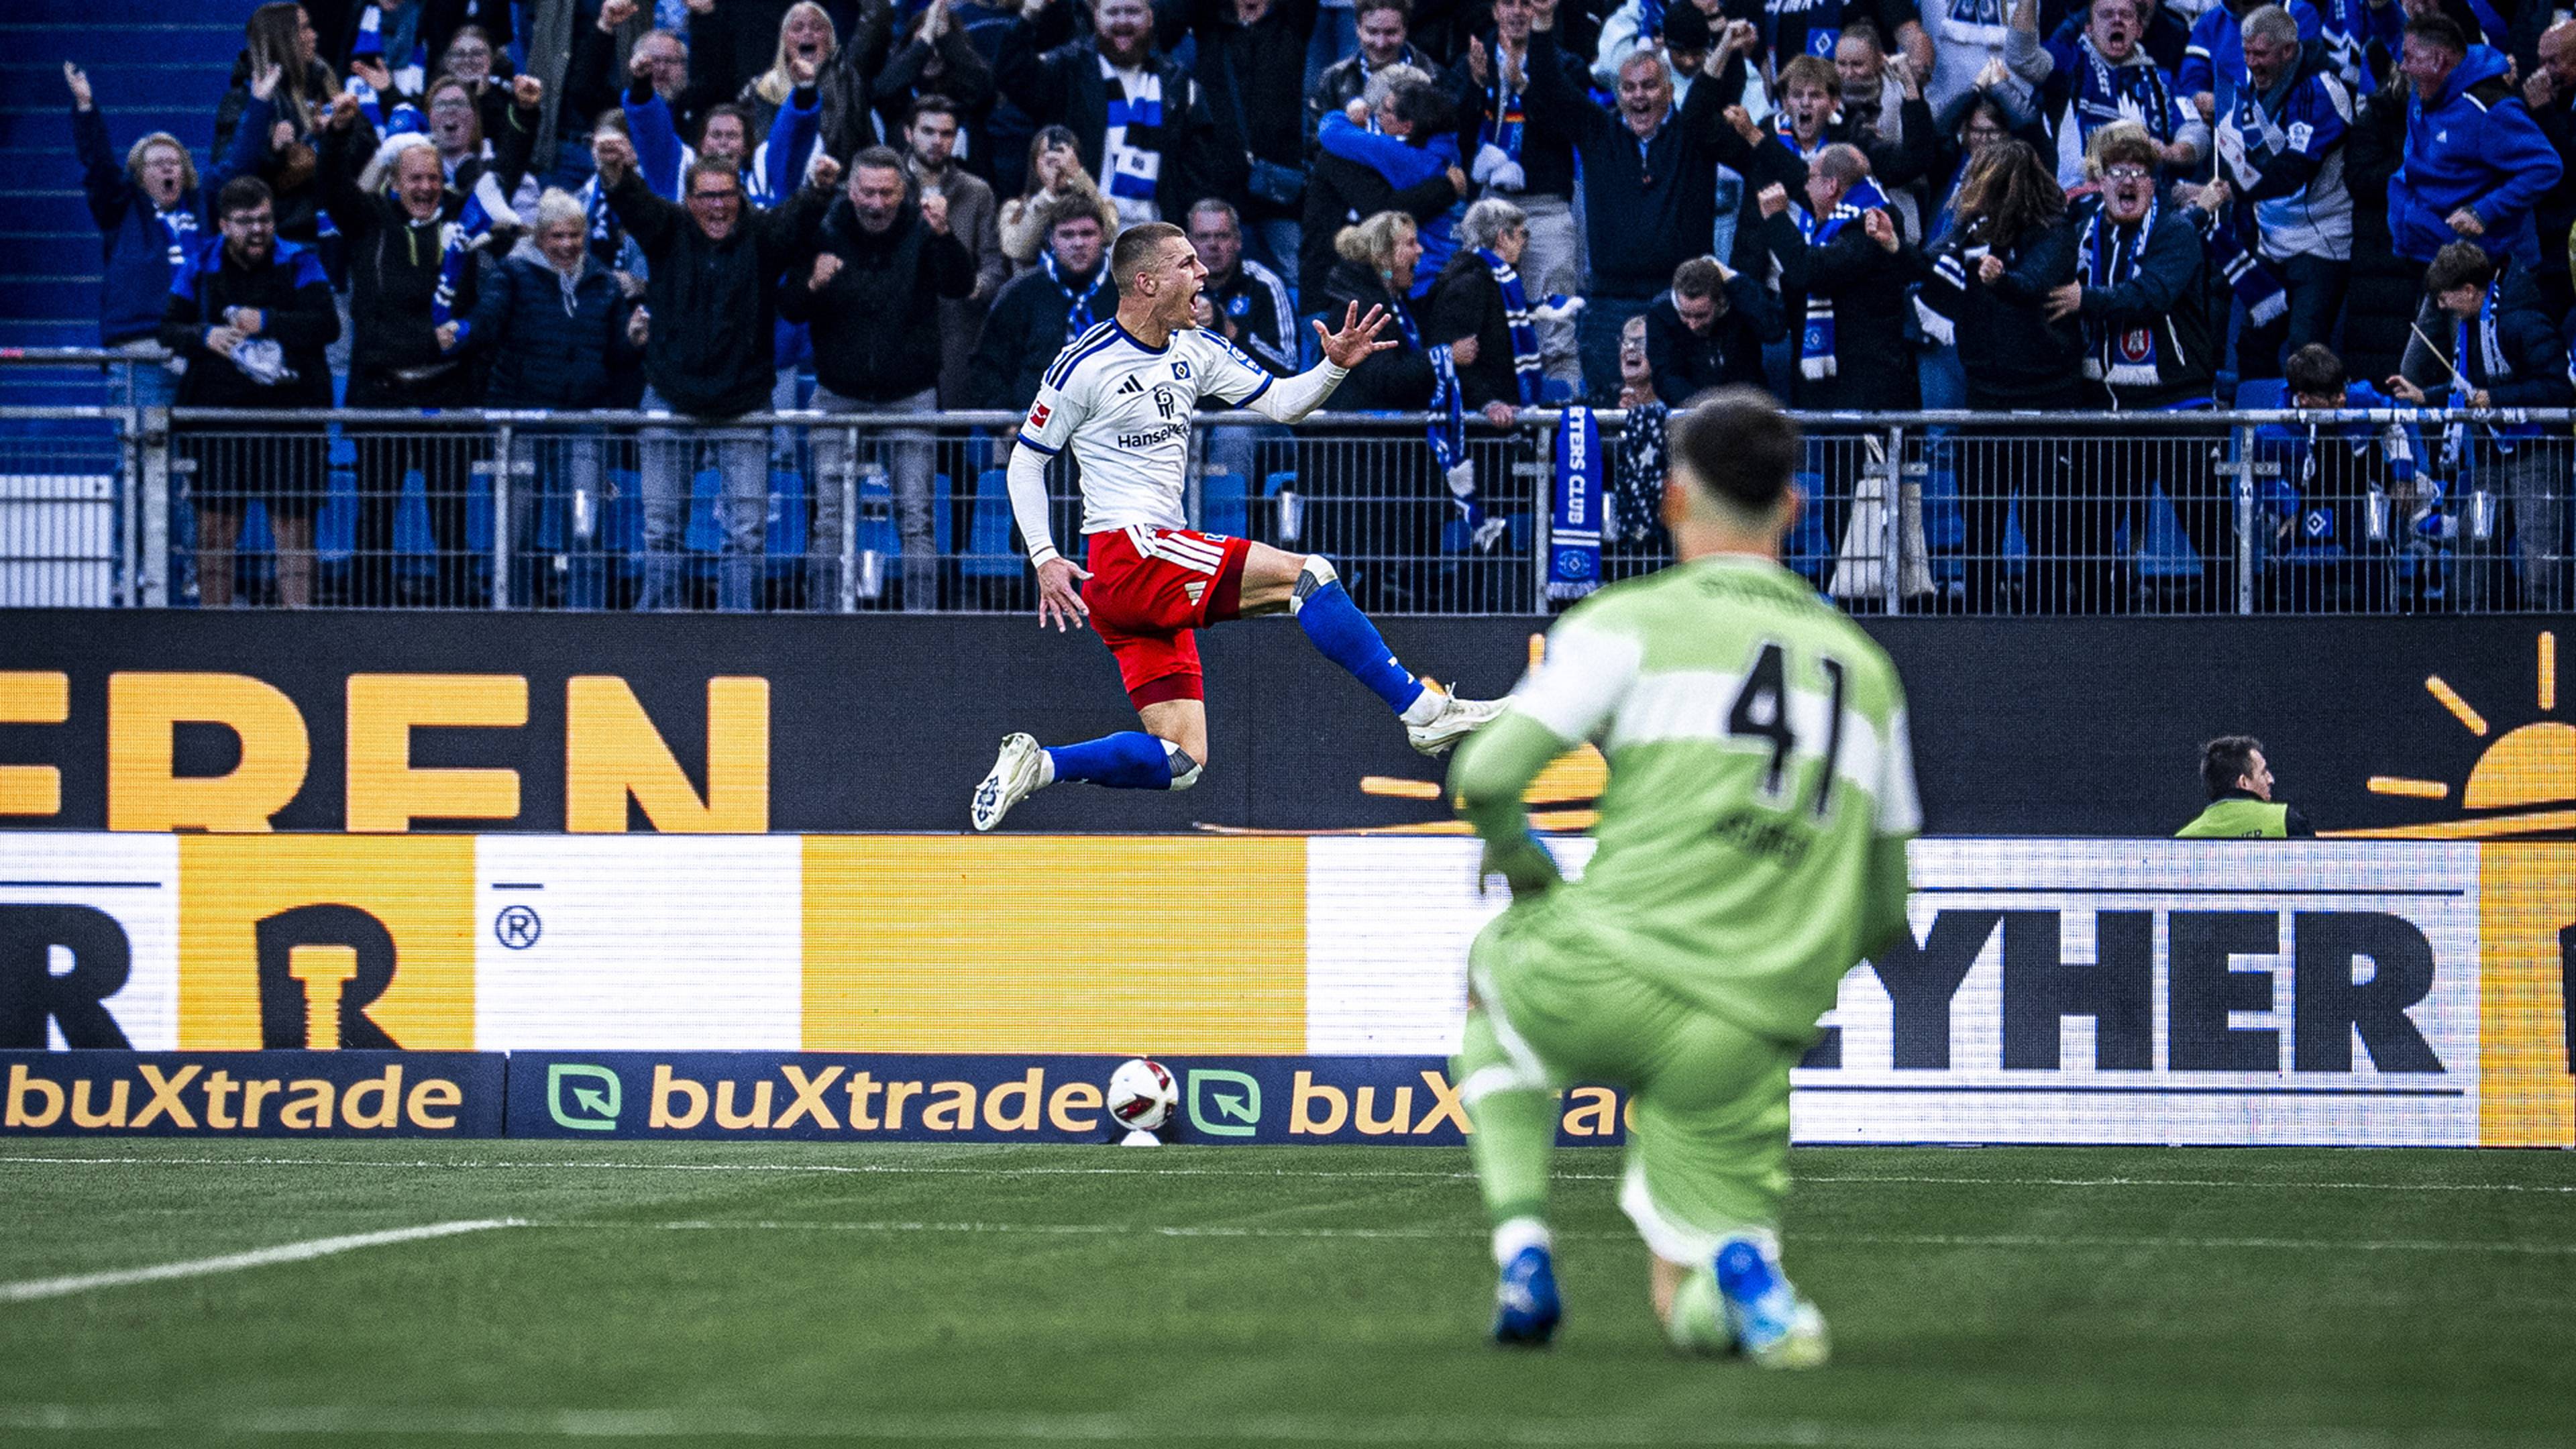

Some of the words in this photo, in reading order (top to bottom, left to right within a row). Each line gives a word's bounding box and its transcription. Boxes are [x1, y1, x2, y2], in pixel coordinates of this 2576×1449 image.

[1568, 474, 1585, 525] CLUB
[1727, 641, 1845, 817] 41
[1801, 909, 2447, 1073] YHER
[5, 1065, 463, 1129] buXtrade
[649, 1065, 1102, 1131] buXtrade
